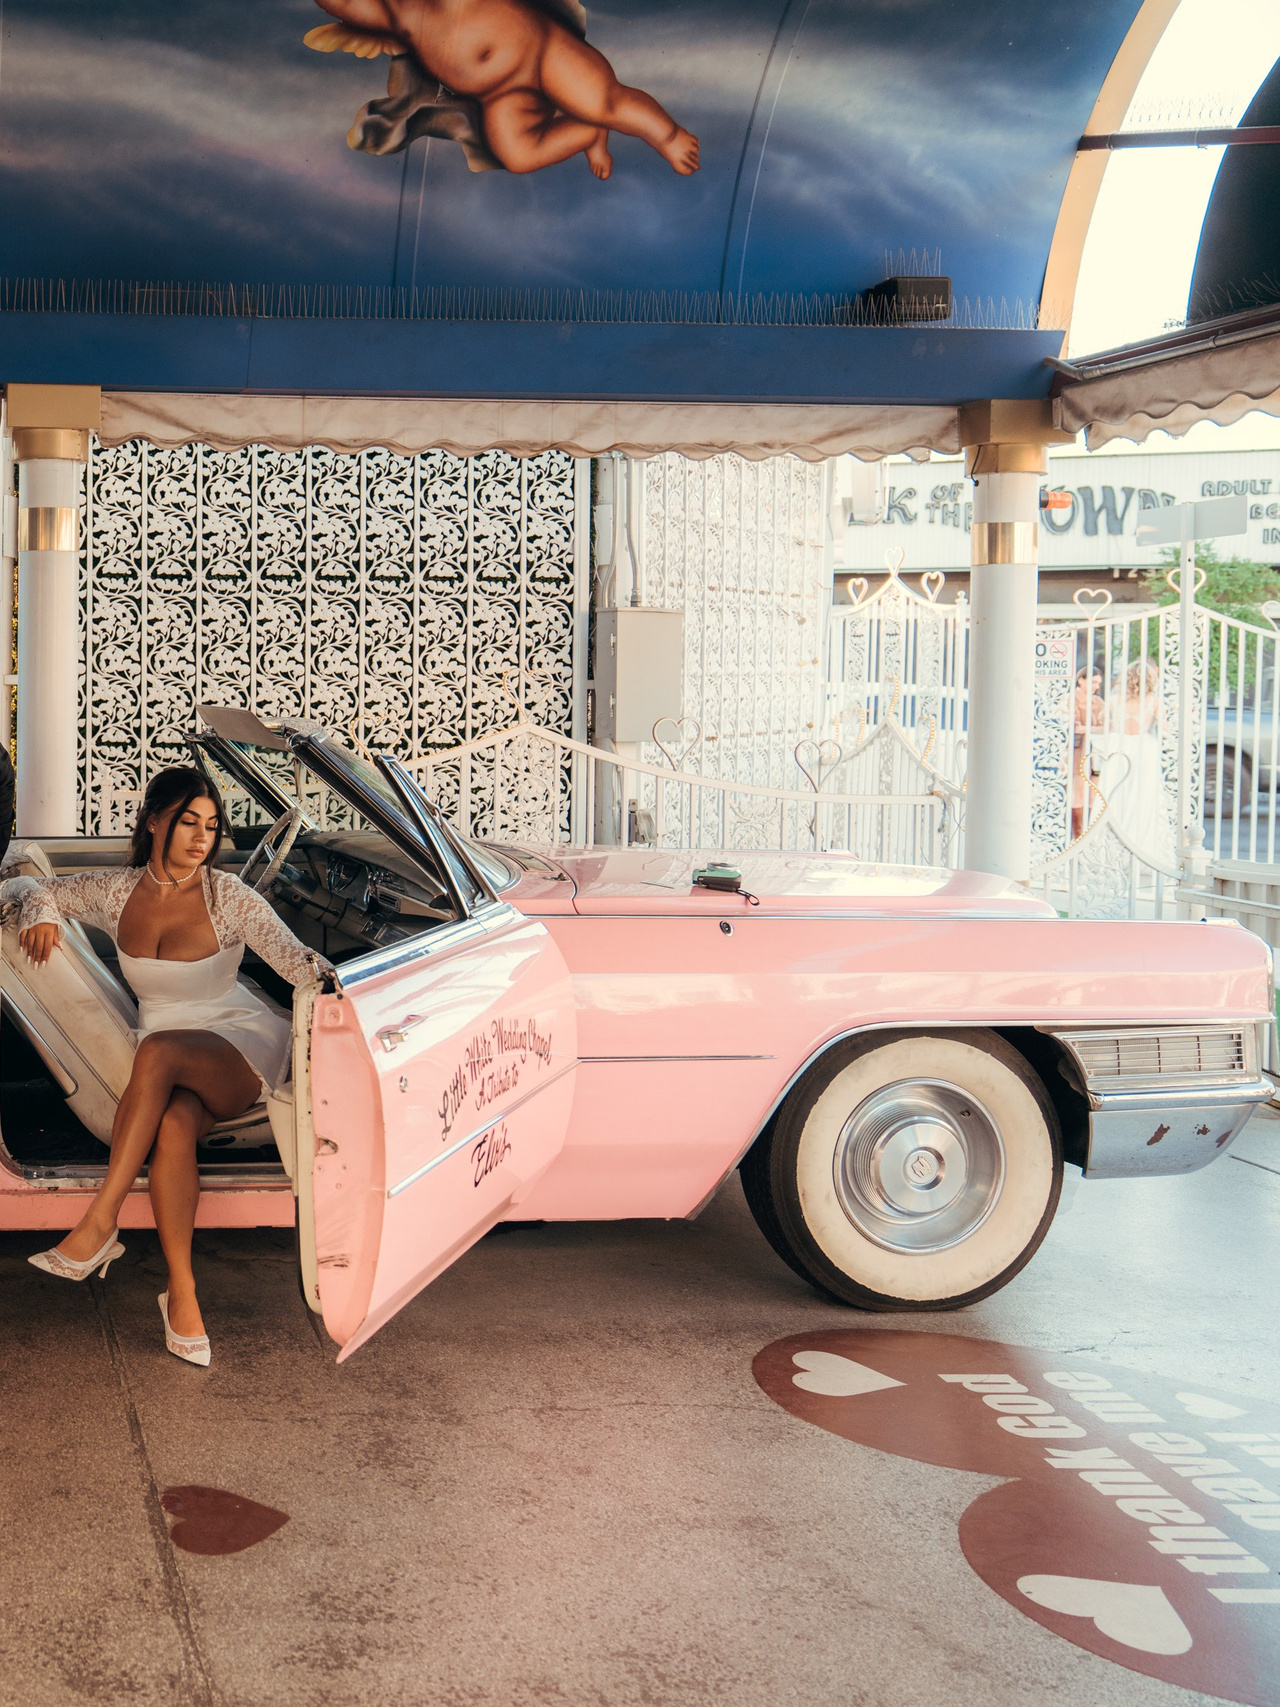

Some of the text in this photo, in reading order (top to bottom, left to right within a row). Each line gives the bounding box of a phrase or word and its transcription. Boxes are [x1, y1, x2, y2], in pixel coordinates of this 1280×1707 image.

[1201, 479, 1273, 497] ADULT
[1250, 503, 1280, 520] BE
[1035, 643, 1047, 657] O
[1035, 660, 1068, 669] OKING
[438, 1017, 552, 1141] Little White Wedding Chapel
[475, 1061, 519, 1111] A Tribute to
[471, 1122, 511, 1187] Elvis
[937, 1373, 1087, 1439] God
[1043, 1371, 1167, 1423] me
[1043, 1447, 1270, 1576] thank
